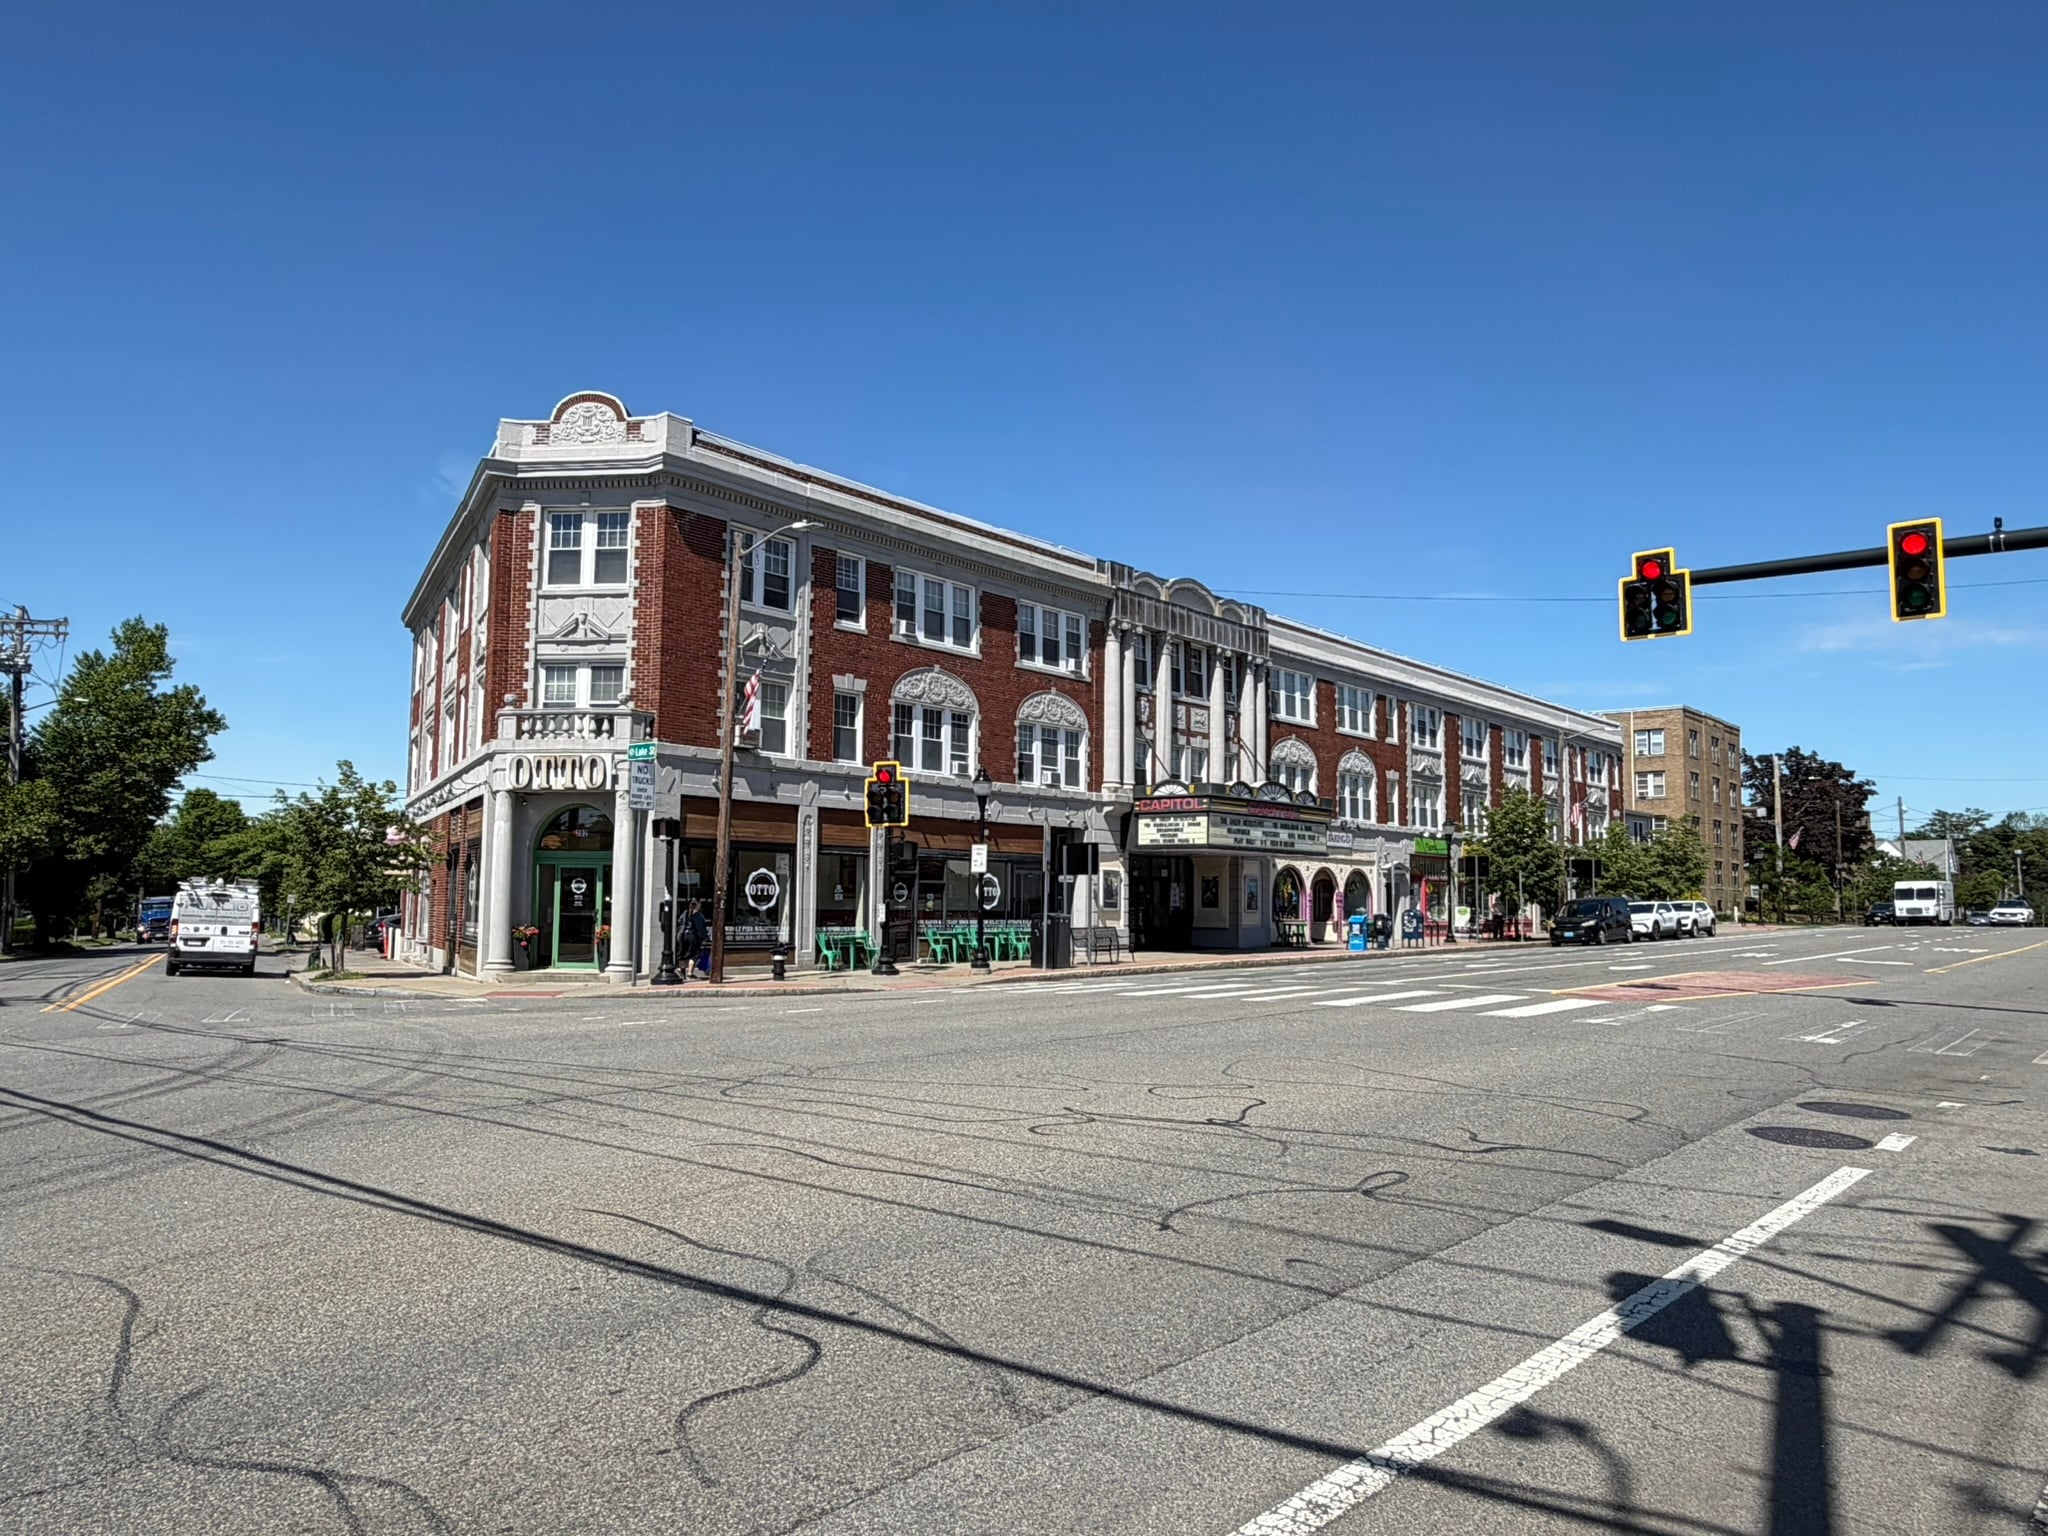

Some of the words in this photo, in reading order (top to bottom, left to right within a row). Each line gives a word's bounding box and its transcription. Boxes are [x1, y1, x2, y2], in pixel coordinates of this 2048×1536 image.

[635, 747, 648, 757] Lake
[509, 754, 607, 789] OTTO
[637, 765, 649, 775] NO
[632, 776, 654, 786] TRUCKS
[1140, 798, 1204, 812] CAPITOL
[750, 884, 776, 896] OTTO
[982, 886, 999, 897] TTO
